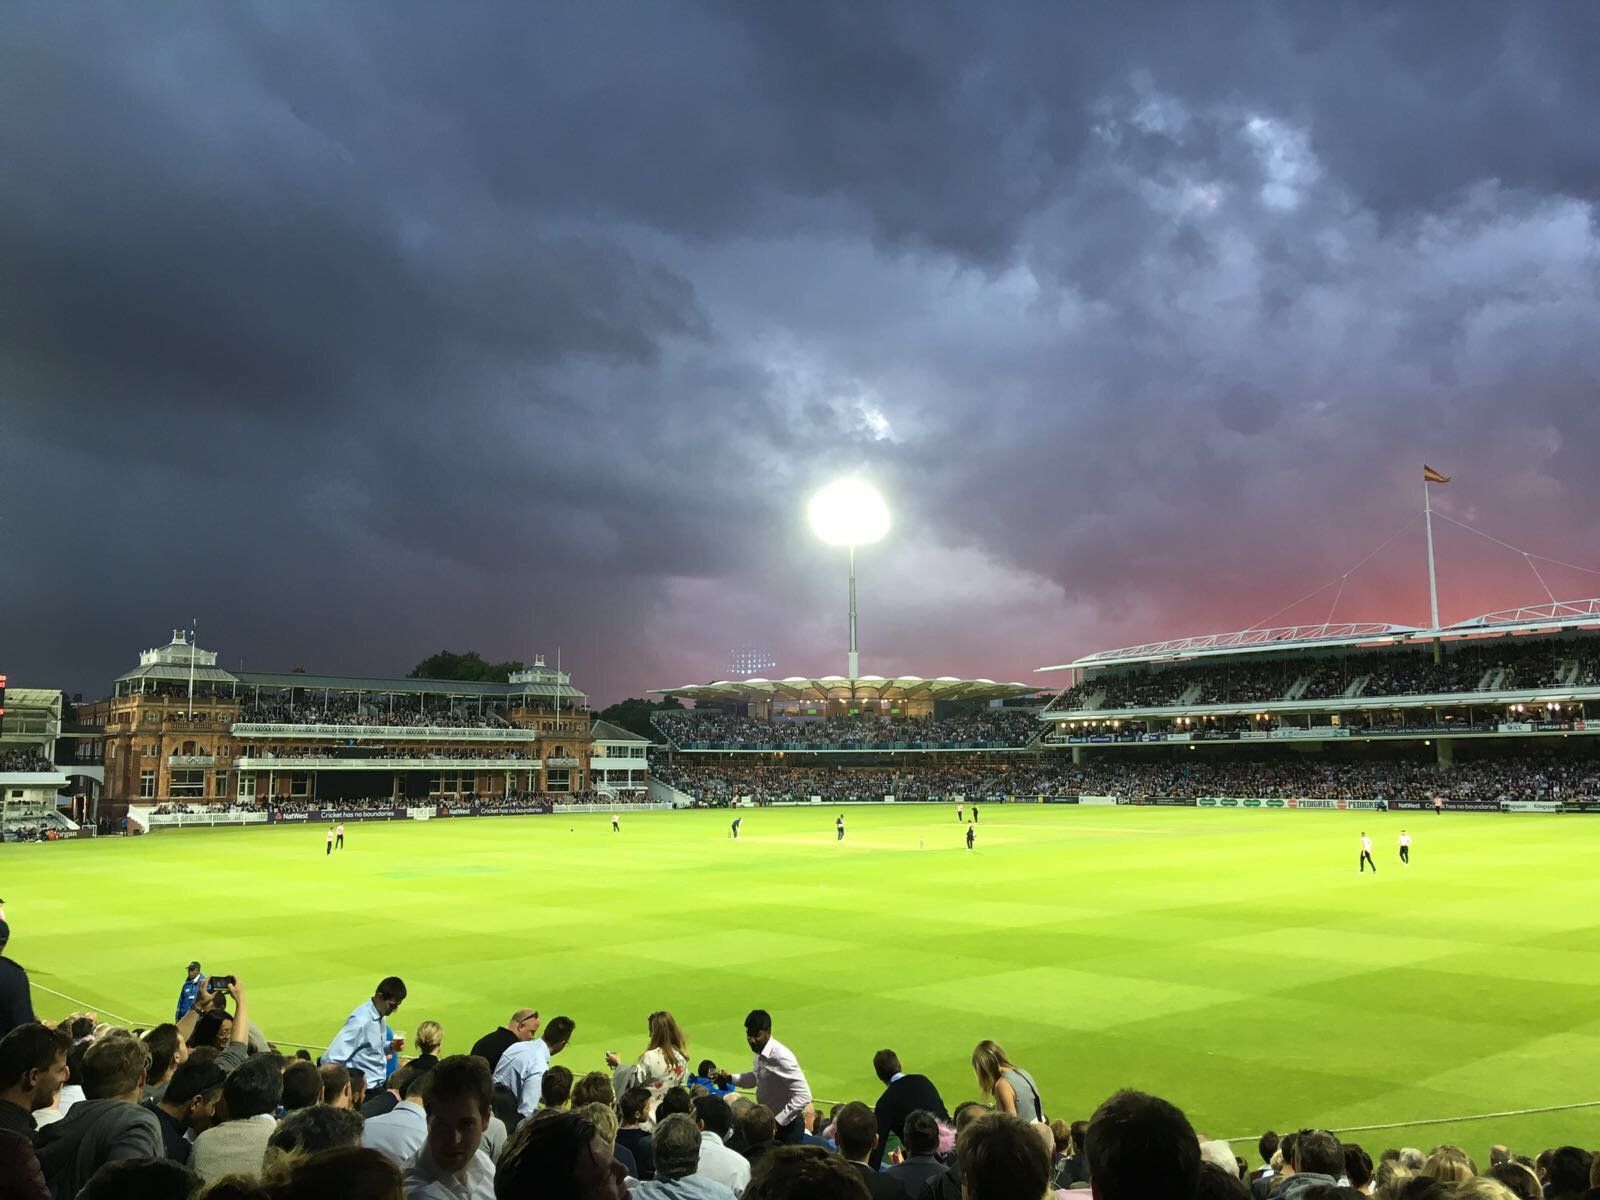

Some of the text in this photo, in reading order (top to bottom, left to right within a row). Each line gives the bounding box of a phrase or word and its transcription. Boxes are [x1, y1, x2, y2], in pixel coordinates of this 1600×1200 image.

[1348, 801, 1379, 809] PEDIGRE
[283, 812, 309, 820] NatWest
[320, 811, 342, 819] Cricket
